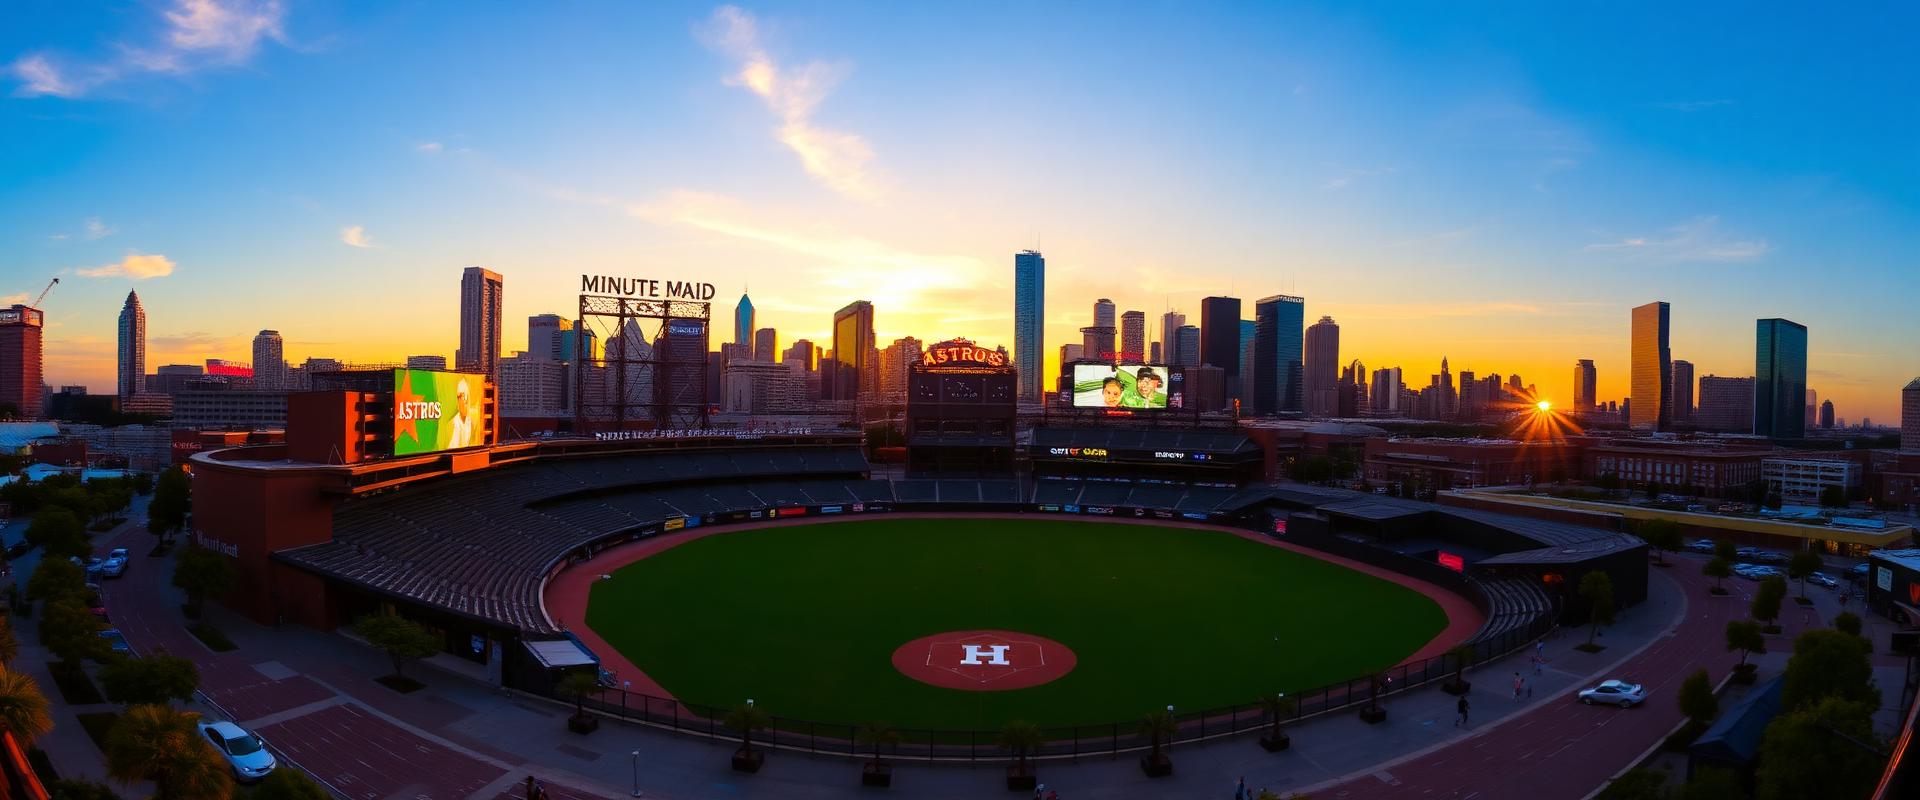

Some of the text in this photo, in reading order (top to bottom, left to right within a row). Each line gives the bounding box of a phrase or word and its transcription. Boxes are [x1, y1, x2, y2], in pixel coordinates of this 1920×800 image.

[582, 274, 716, 300] MINUTE MAID
[399, 401, 441, 419] ASTROS
[960, 645, 1010, 665] H
